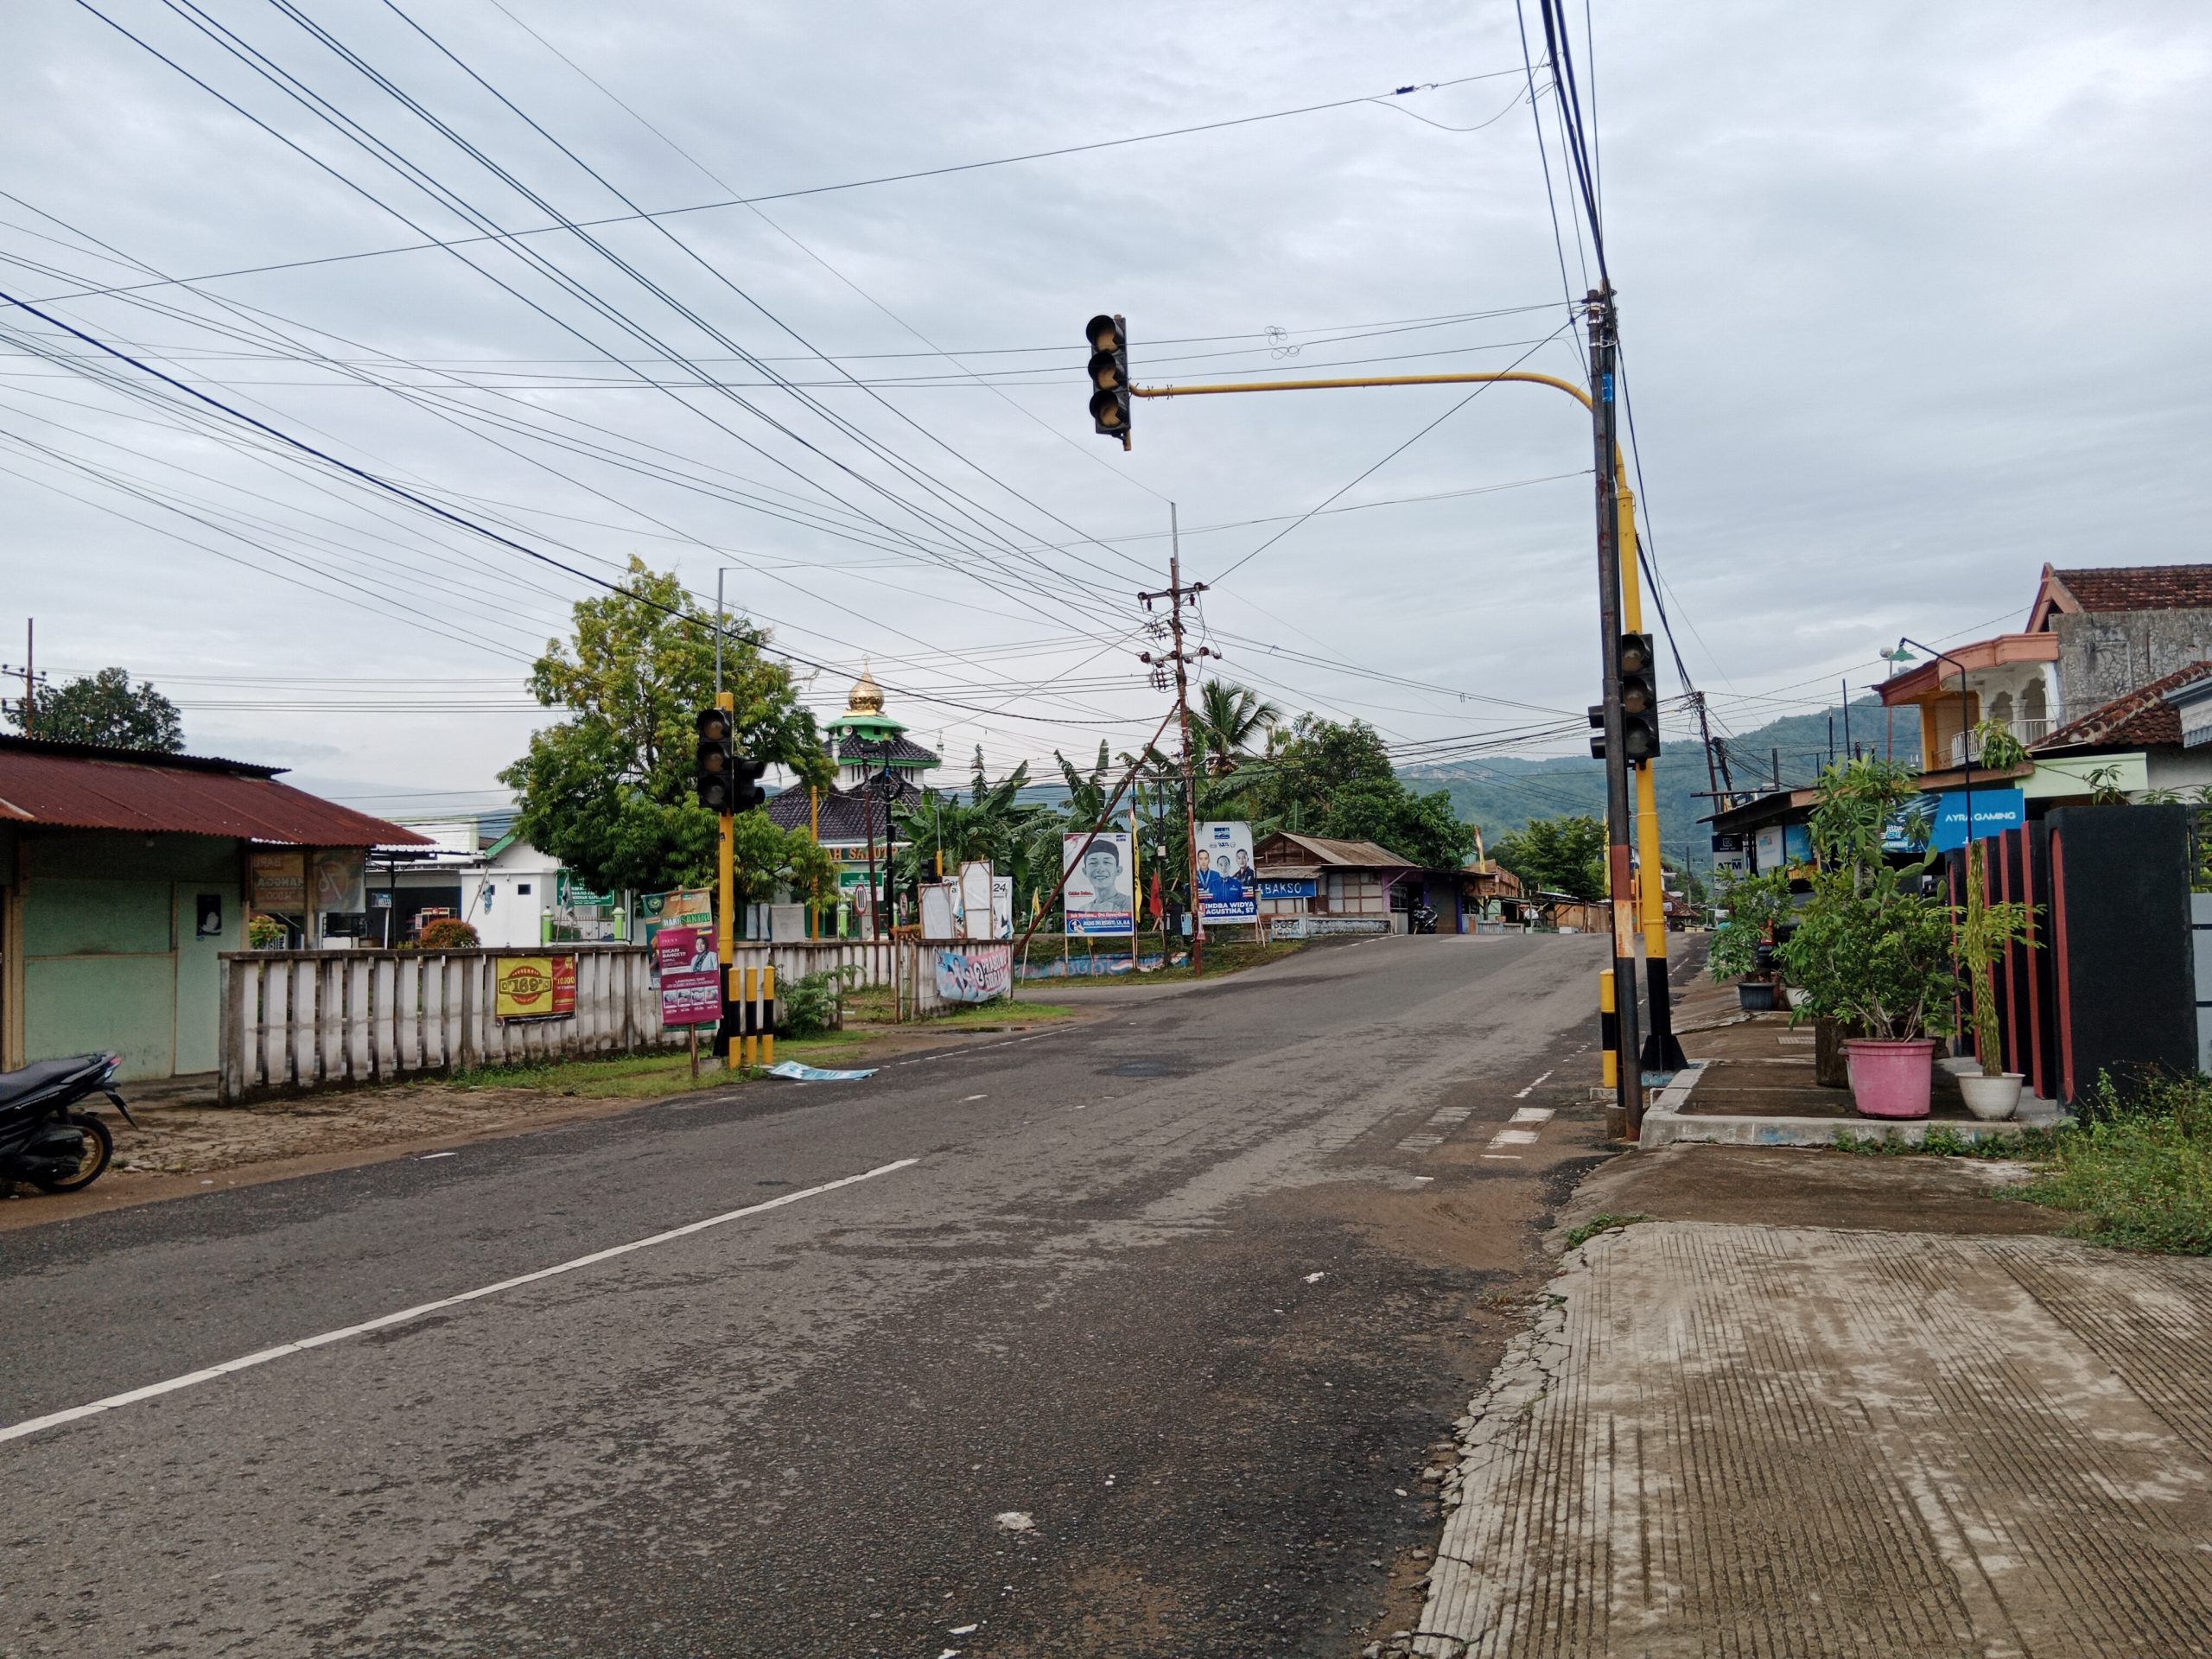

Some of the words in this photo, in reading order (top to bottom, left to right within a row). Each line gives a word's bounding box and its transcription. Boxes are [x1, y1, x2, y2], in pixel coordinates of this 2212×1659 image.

[1945, 813, 1973, 822] AYRA
[1974, 811, 2017, 821] GAMING
[1717, 861, 1742, 870] ATM
[1265, 882, 1302, 894] BAKSO
[663, 918, 680, 927] HARI
[680, 912, 710, 925] SANTRI
